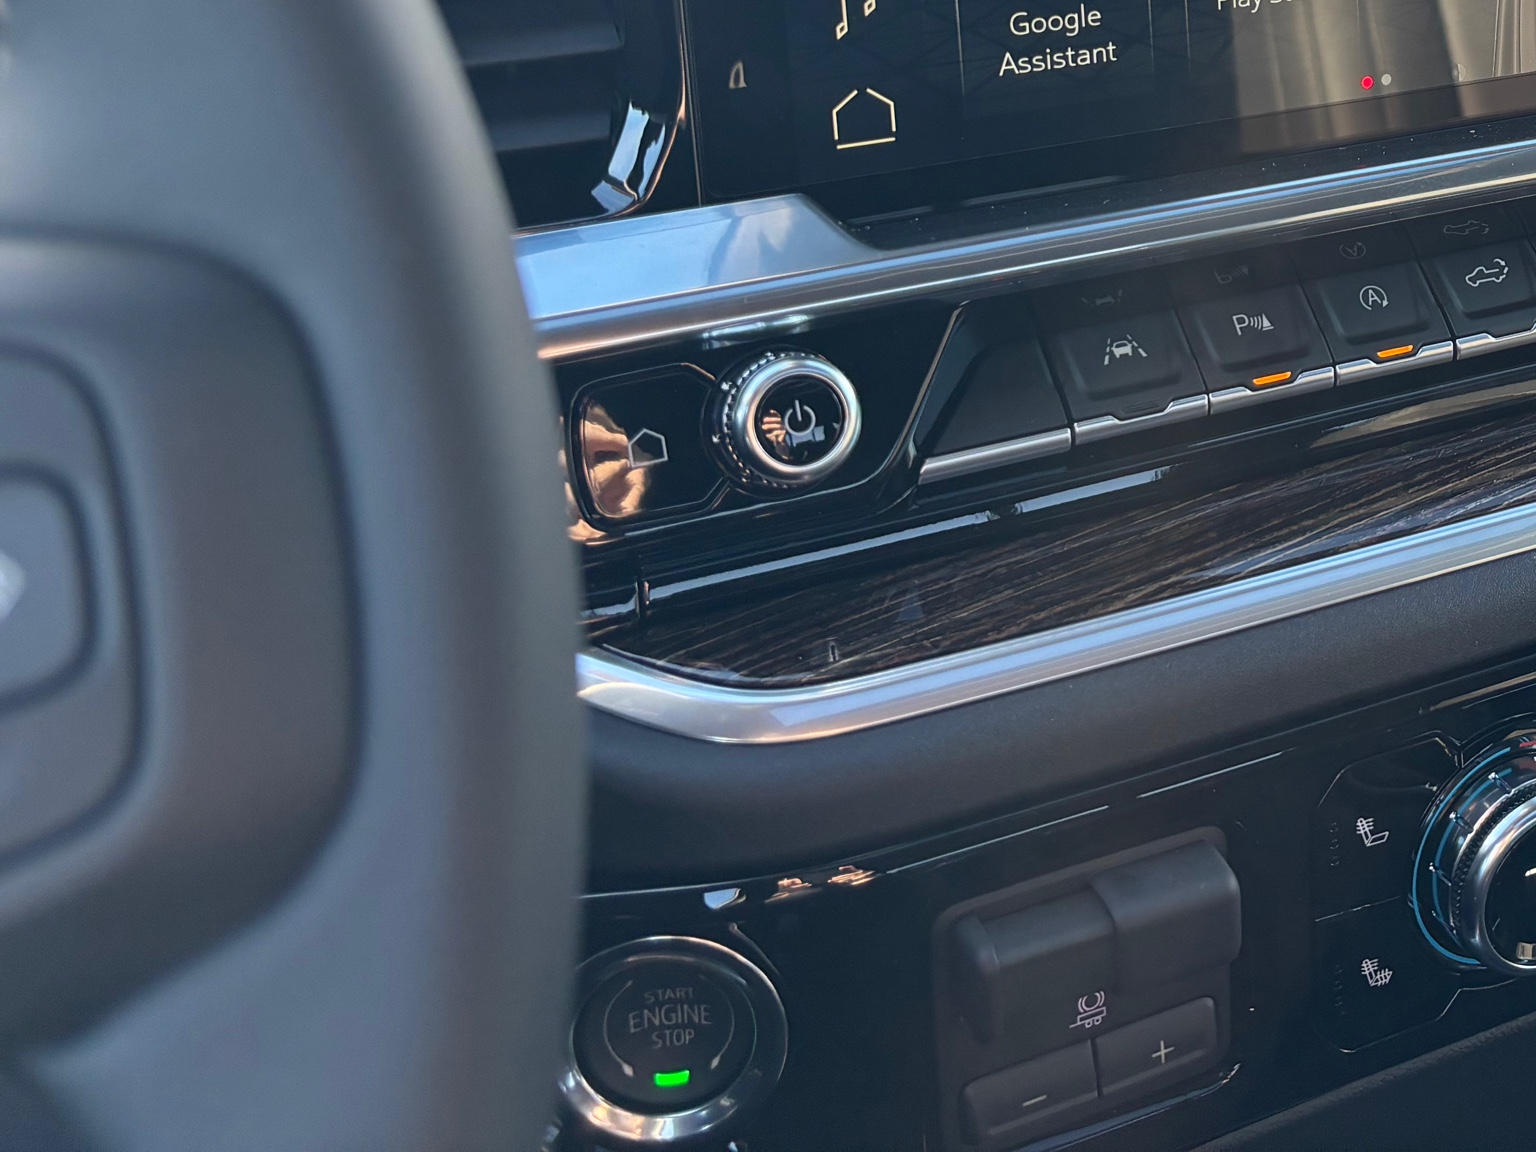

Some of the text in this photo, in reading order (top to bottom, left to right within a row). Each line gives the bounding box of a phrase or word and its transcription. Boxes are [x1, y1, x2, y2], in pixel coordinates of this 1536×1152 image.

[1010, 3, 1102, 37] Google
[999, 42, 1118, 77] Assistant
[644, 987, 694, 1004] START
[628, 1004, 712, 1034] ENGINE
[651, 1029, 695, 1049] STOP
